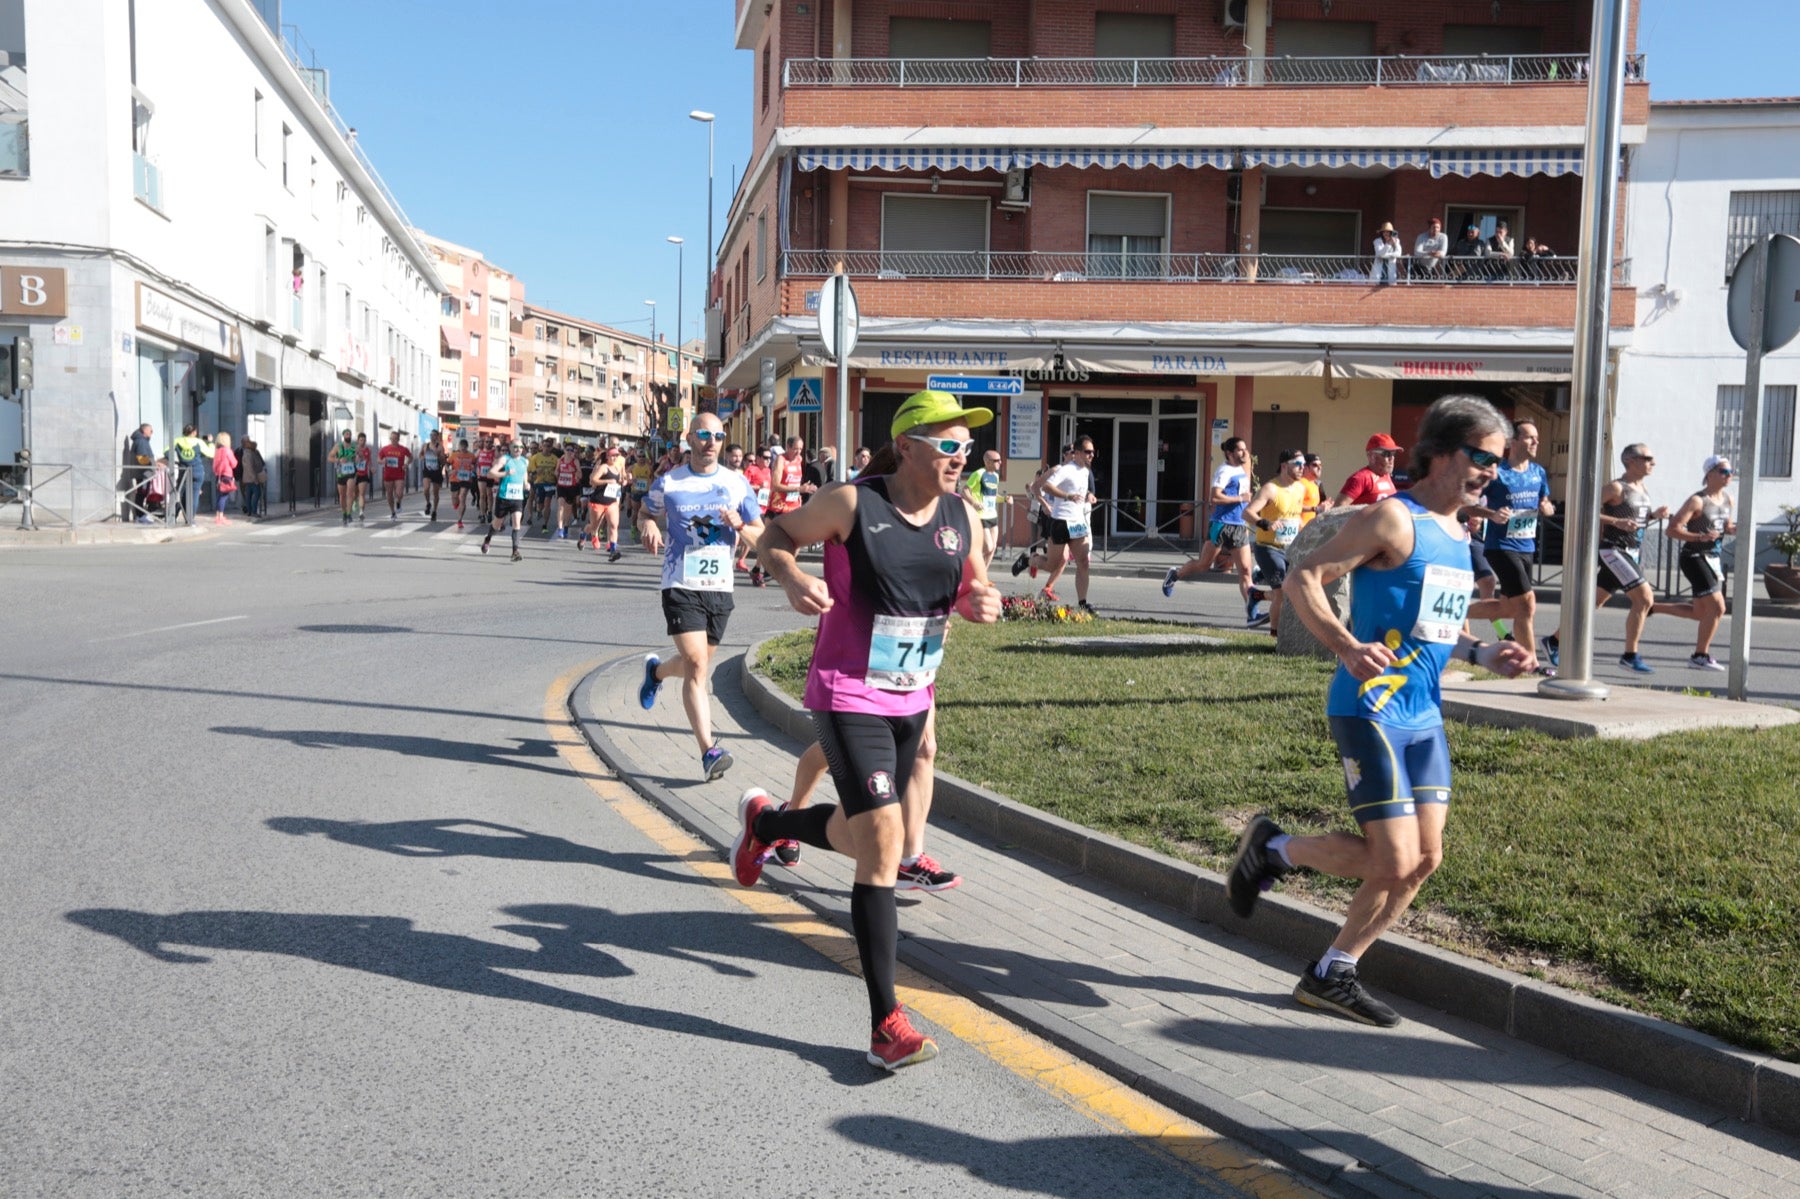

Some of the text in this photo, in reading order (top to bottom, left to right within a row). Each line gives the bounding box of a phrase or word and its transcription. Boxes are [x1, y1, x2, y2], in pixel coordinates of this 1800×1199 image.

[20, 274, 47, 306] B
[881, 350, 1008, 366] RESTAURANTE
[1152, 354, 1227, 370] PARADA
[930, 380, 968, 390] Granada
[676, 504, 701, 512] TODO
[1281, 525, 1297, 536] 204
[1515, 518, 1533, 529] 510
[699, 560, 719, 575] 25
[1432, 591, 1465, 620] 443
[898, 641, 928, 668] 71
